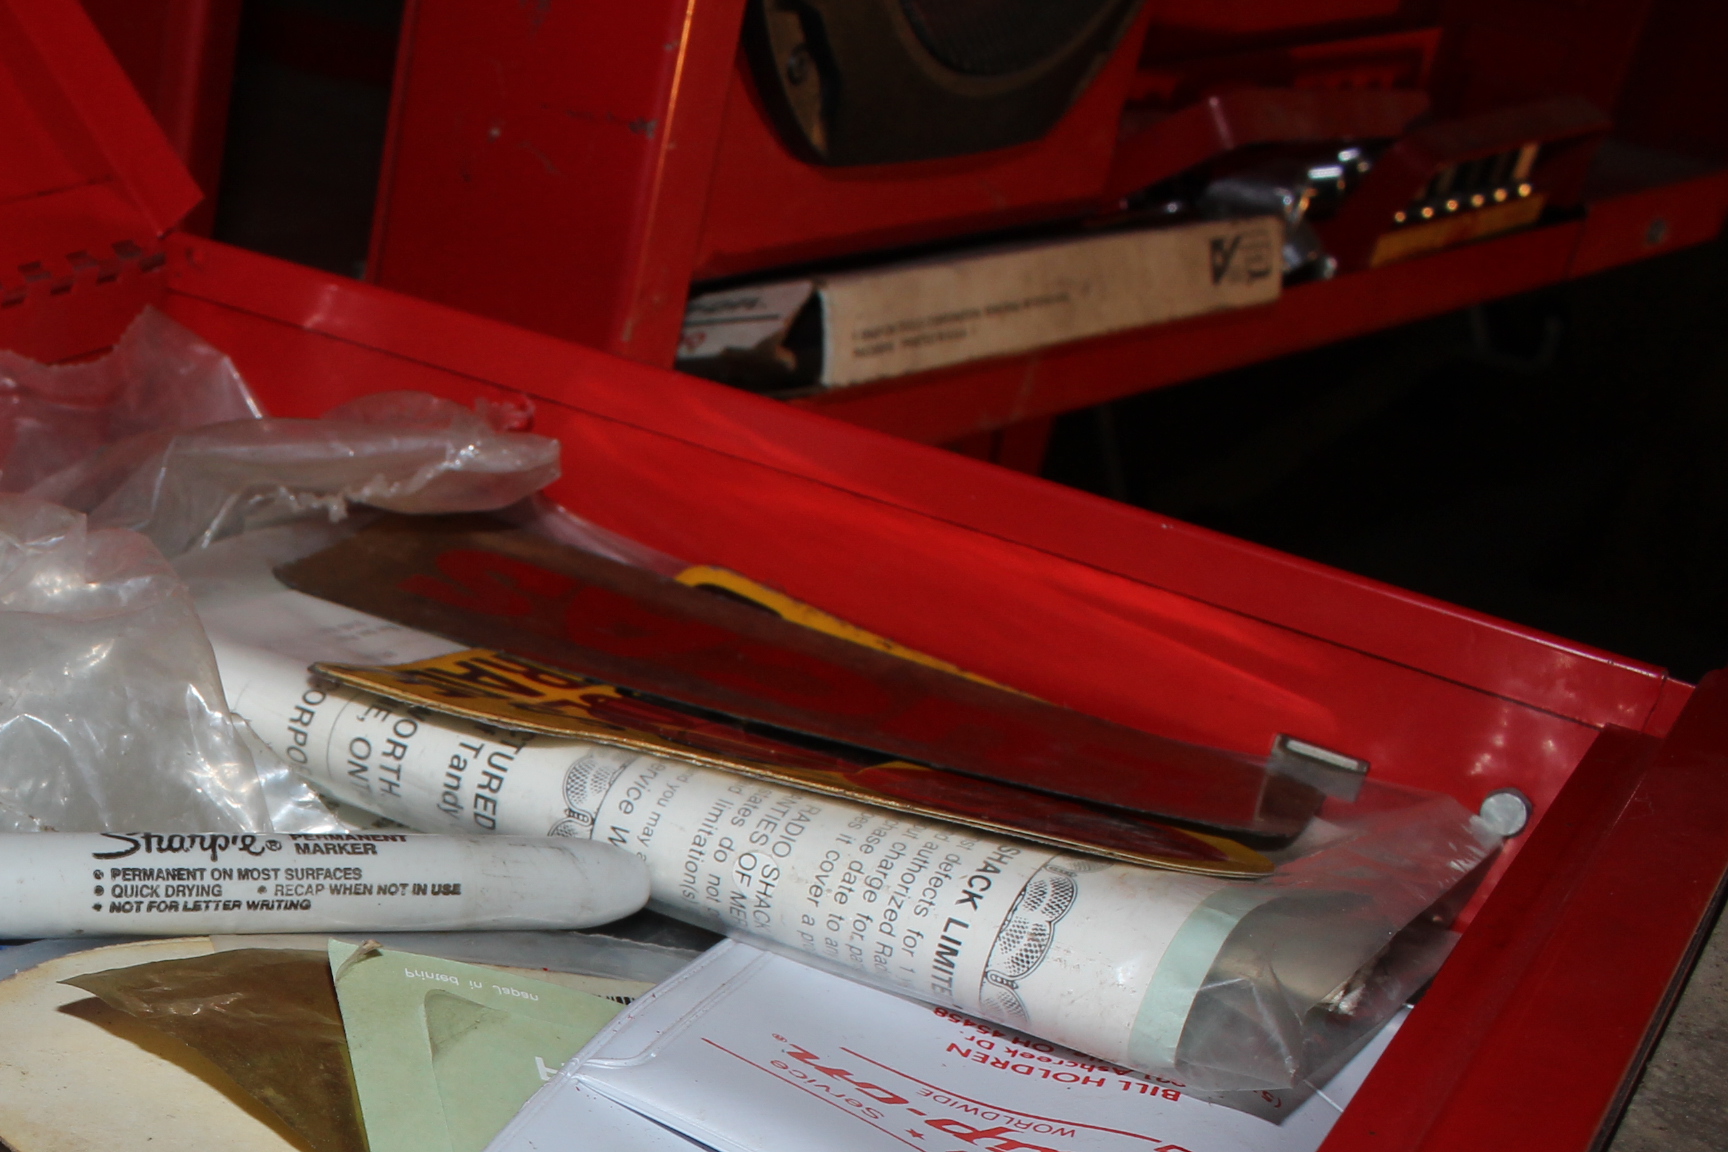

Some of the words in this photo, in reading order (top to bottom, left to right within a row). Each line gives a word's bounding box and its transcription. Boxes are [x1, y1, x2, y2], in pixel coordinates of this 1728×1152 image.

[656, 781, 679, 808] you
[636, 810, 662, 849] may
[772, 803, 822, 858] RADIO
[294, 843, 378, 855] MARKER
[713, 836, 735, 863] do
[110, 867, 207, 882] PERMANENT
[210, 867, 234, 881] ON
[237, 867, 281, 881] MOST
[284, 867, 363, 881] SURFACES
[706, 872, 721, 903] not
[734, 852, 758, 888] OF
[806, 849, 841, 908] cover
[834, 859, 864, 906] date
[862, 840, 908, 905] charge
[914, 853, 963, 919] defects
[955, 844, 1023, 912] SHACK
[109, 900, 144, 913] NOT
[146, 900, 180, 913] FOR
[182, 900, 242, 912] LETTER
[246, 899, 312, 911] WRITING
[111, 884, 160, 898] QUICK
[164, 884, 223, 898] DRYING
[274, 883, 325, 897] RECAP
[329, 883, 373, 896] WHEN
[376, 883, 409, 896] NOT
[412, 883, 428, 896] IN
[431, 883, 462, 896] USE
[752, 863, 780, 931] SHACK
[878, 841, 940, 938] authorized
[826, 912, 845, 933] to
[901, 927, 925, 959] for
[945, 1042, 1113, 1088] HOLDREN
[769, 1058, 885, 1121] Service
[1121, 1079, 1183, 1103] BILL
[914, 1087, 1077, 1139] WORLDWIDE
